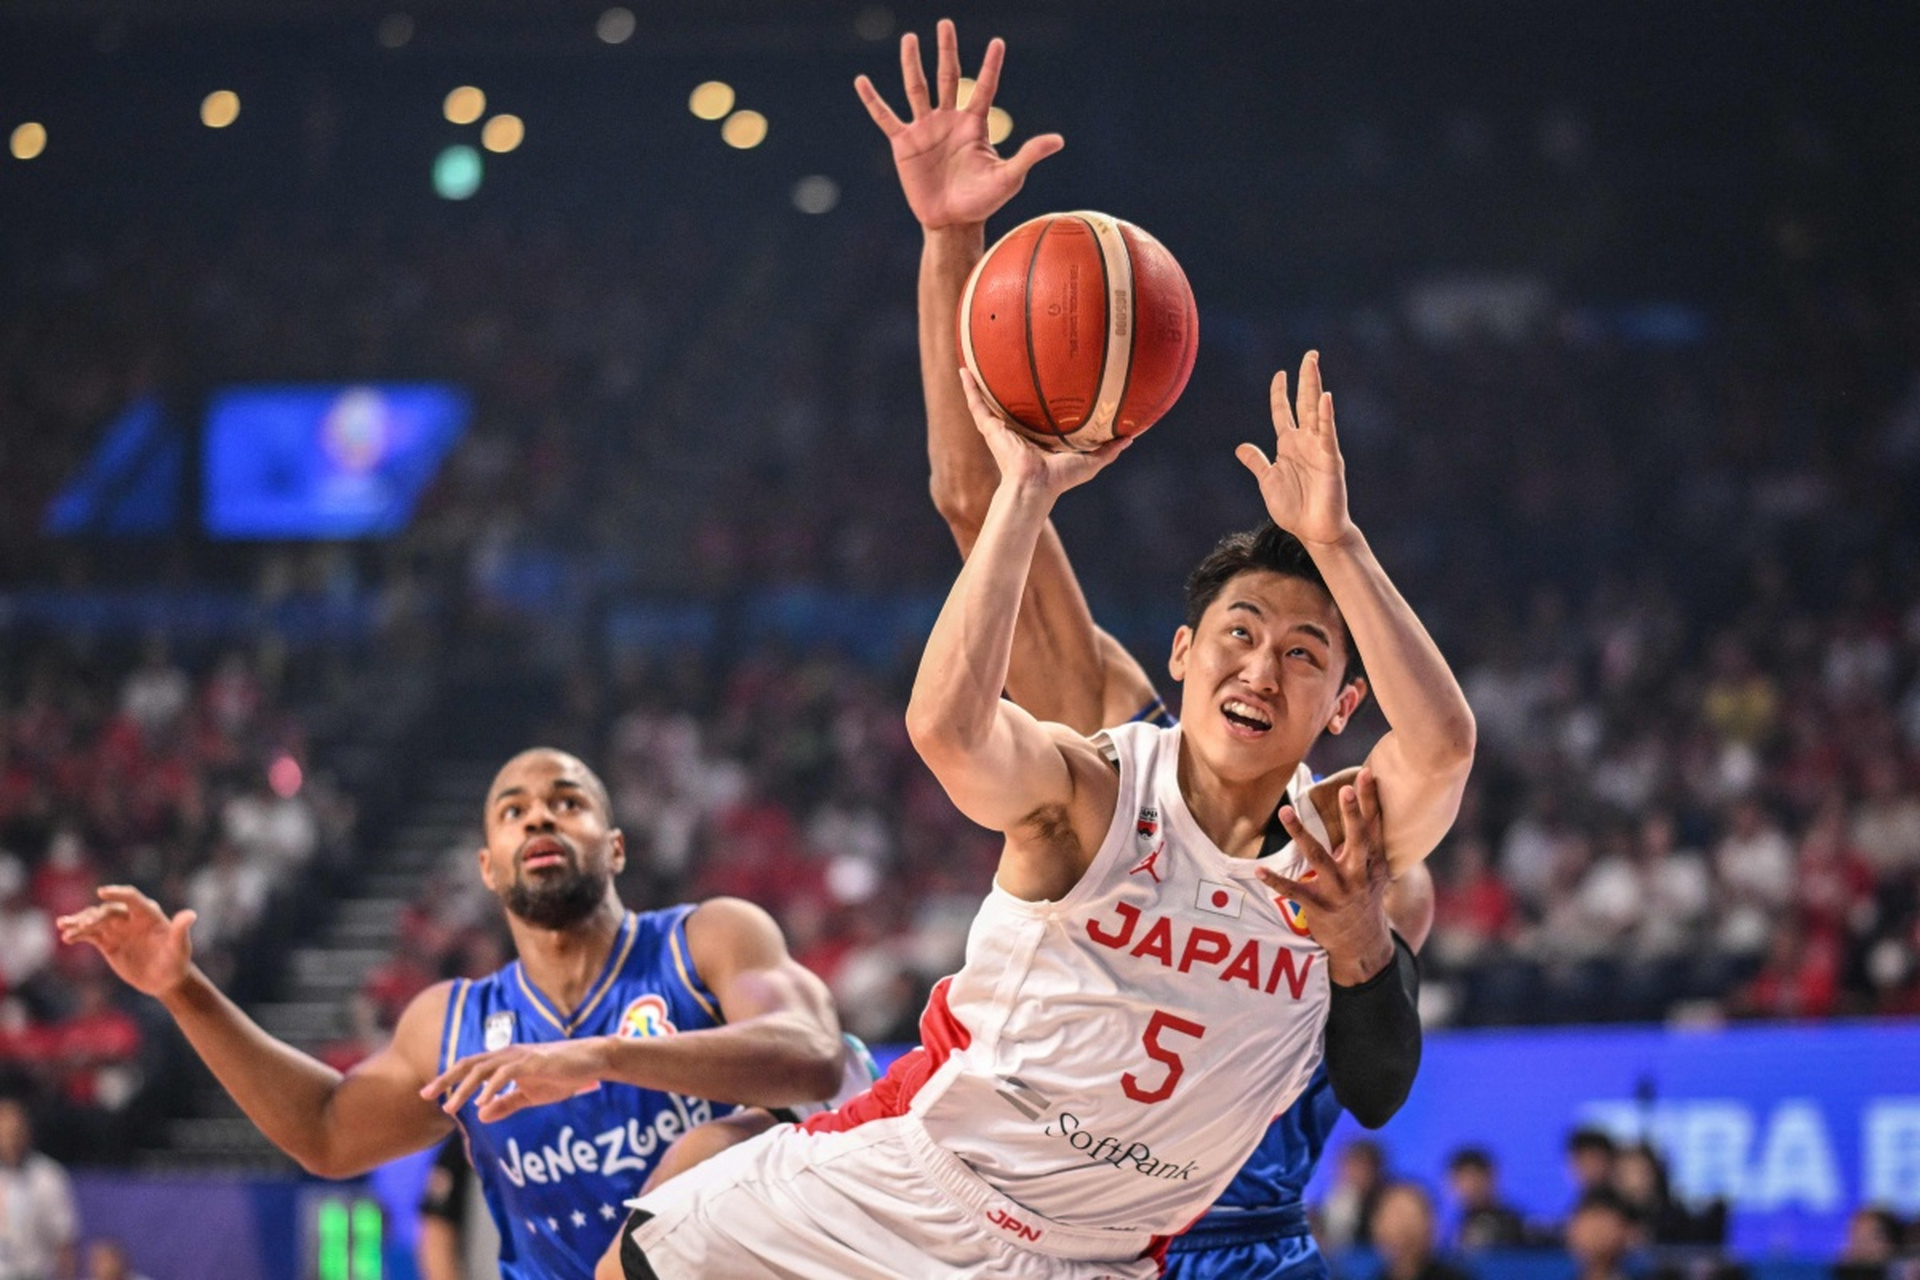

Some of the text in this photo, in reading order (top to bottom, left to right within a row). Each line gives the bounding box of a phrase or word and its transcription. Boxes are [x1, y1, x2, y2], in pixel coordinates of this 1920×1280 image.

[1086, 901, 1315, 1000] JAPAN
[1120, 1009, 1206, 1105] 5
[986, 1209, 1042, 1243] JPN
